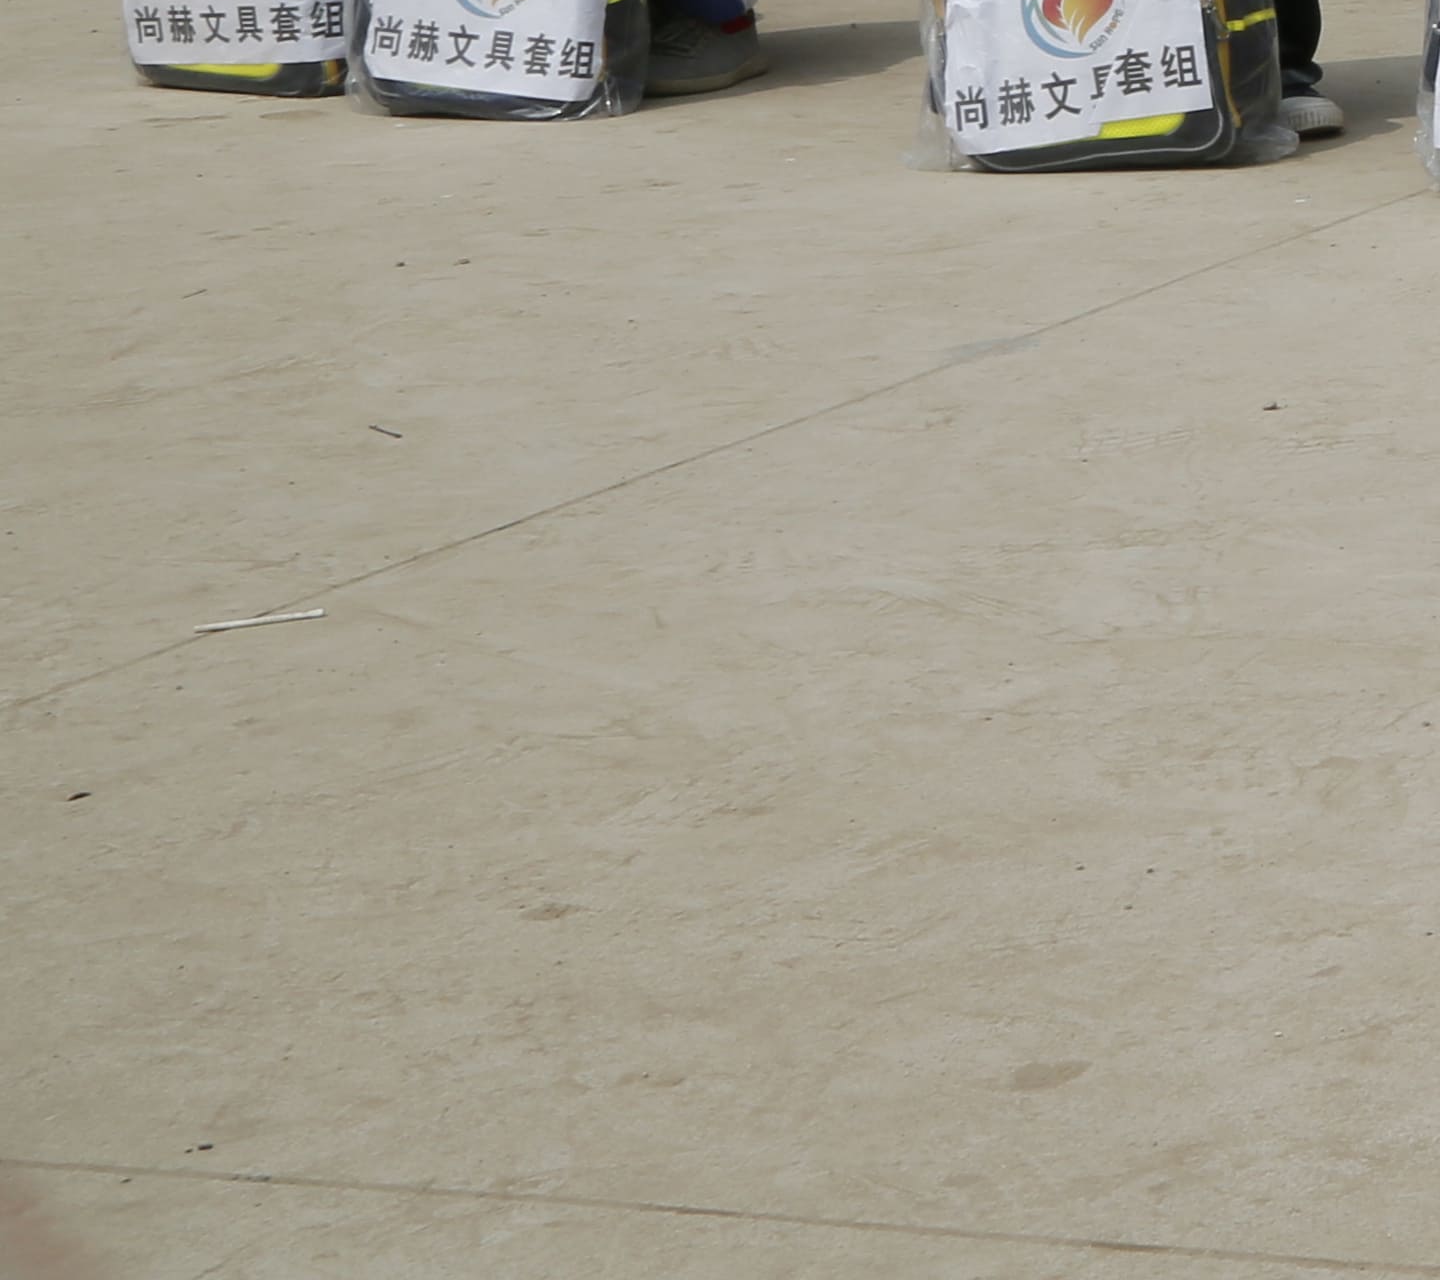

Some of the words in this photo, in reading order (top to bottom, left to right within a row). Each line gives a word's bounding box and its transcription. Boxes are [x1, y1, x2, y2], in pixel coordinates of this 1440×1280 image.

[134, 0, 346, 44] 尚赫文具套组
[371, 15, 596, 79] 尚赫文具套组
[955, 45, 1203, 131] 尚赫文具套组
